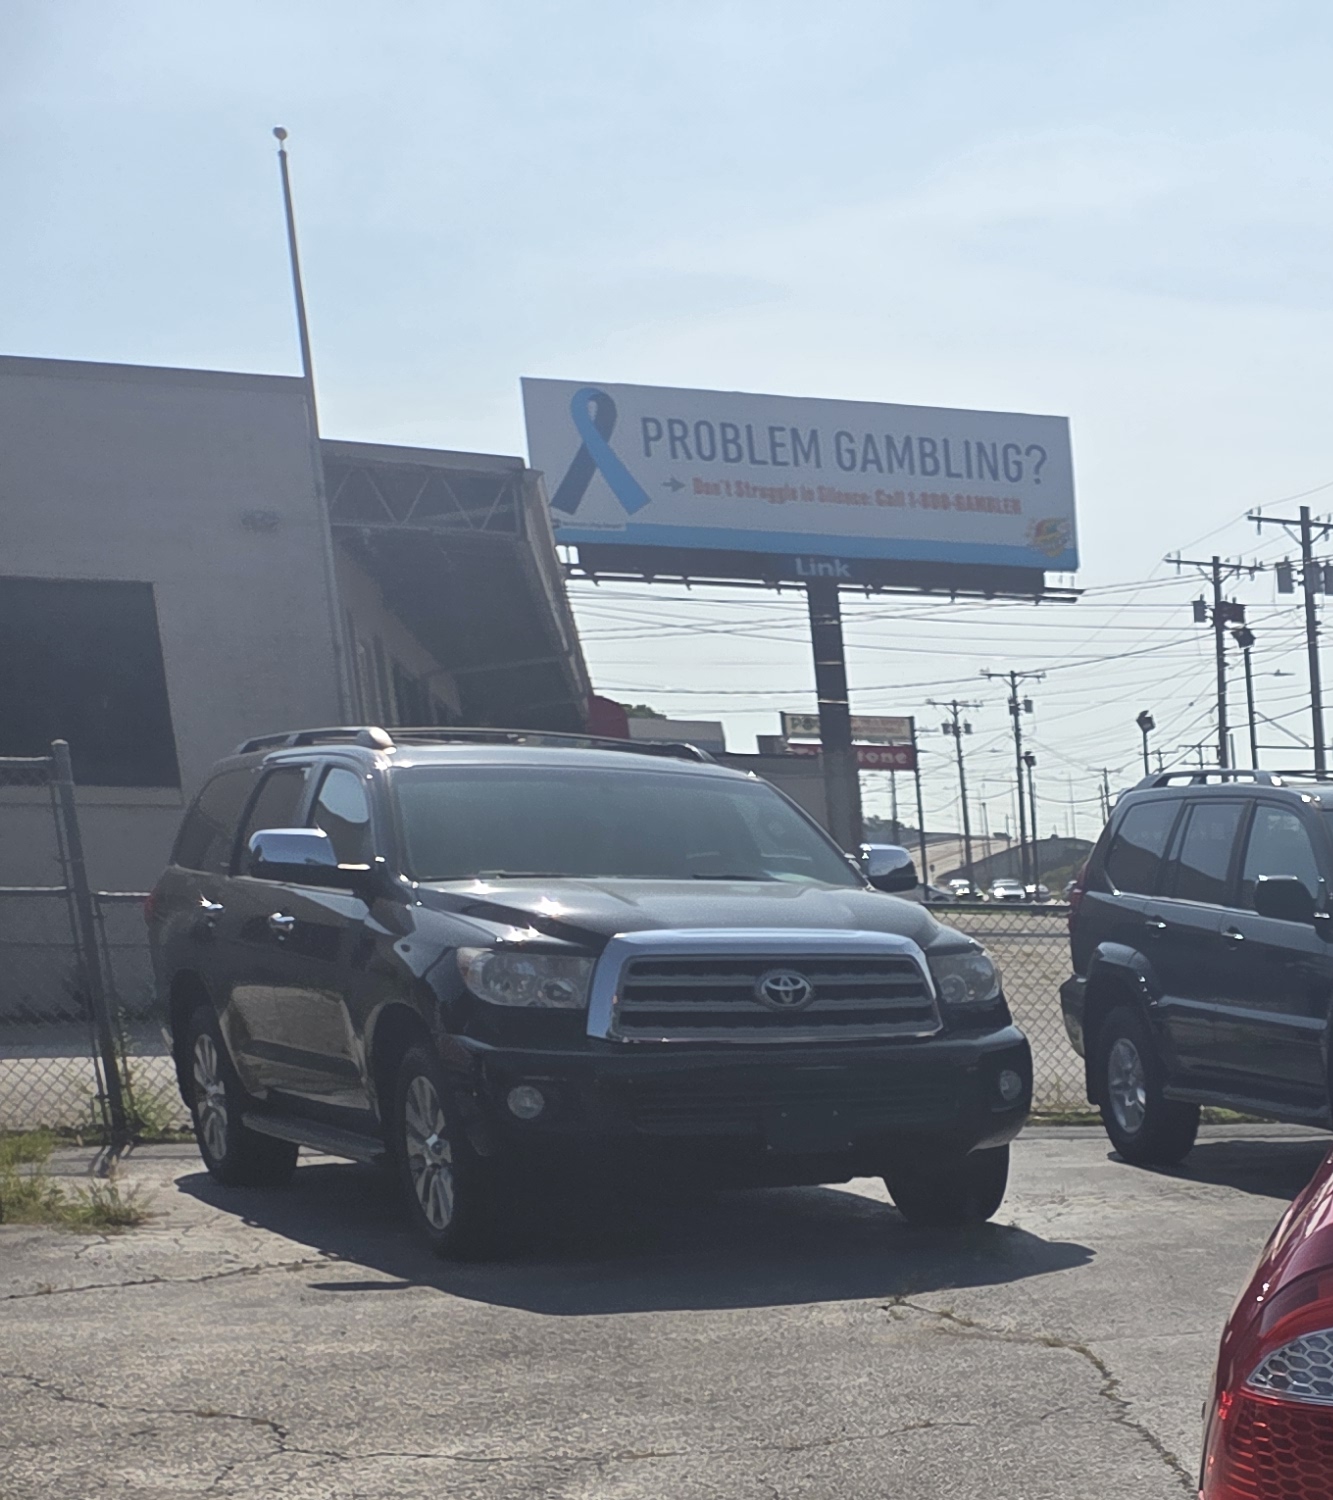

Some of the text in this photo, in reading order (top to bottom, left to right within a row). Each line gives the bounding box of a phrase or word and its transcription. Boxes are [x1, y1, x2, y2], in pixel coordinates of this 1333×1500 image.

[641, 416, 1048, 485] PROBLEM GAMBLING?
[795, 557, 852, 578] Link
